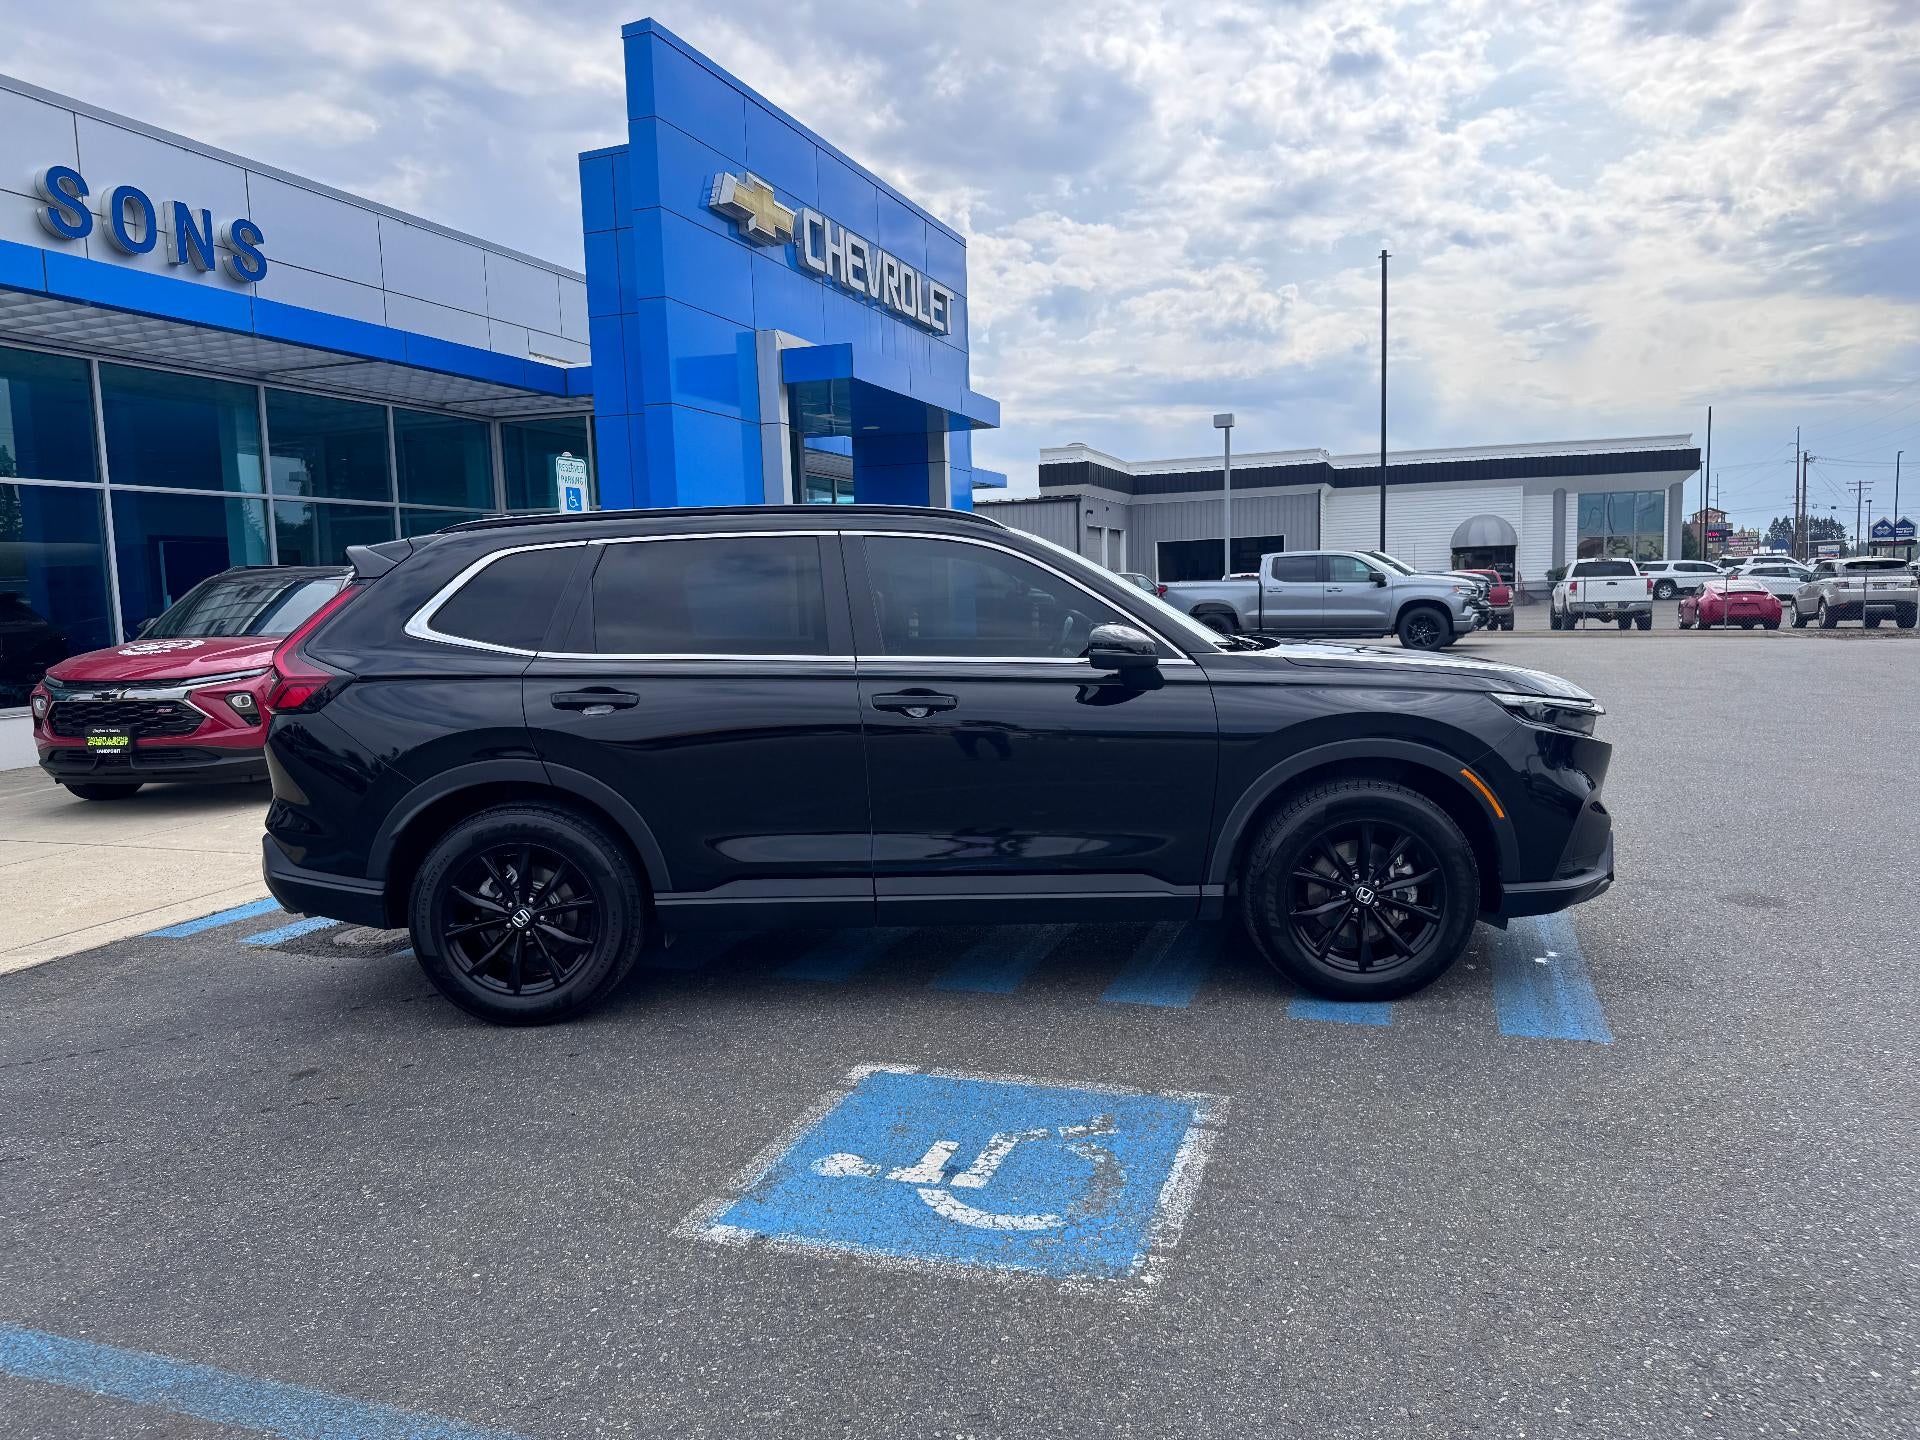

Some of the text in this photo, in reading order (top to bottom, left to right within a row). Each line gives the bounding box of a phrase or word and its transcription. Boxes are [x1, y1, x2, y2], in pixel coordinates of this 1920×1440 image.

[36, 165, 268, 283] SONS
[794, 207, 955, 336] CHEVROLET
[561, 475, 584, 485] PARKING
